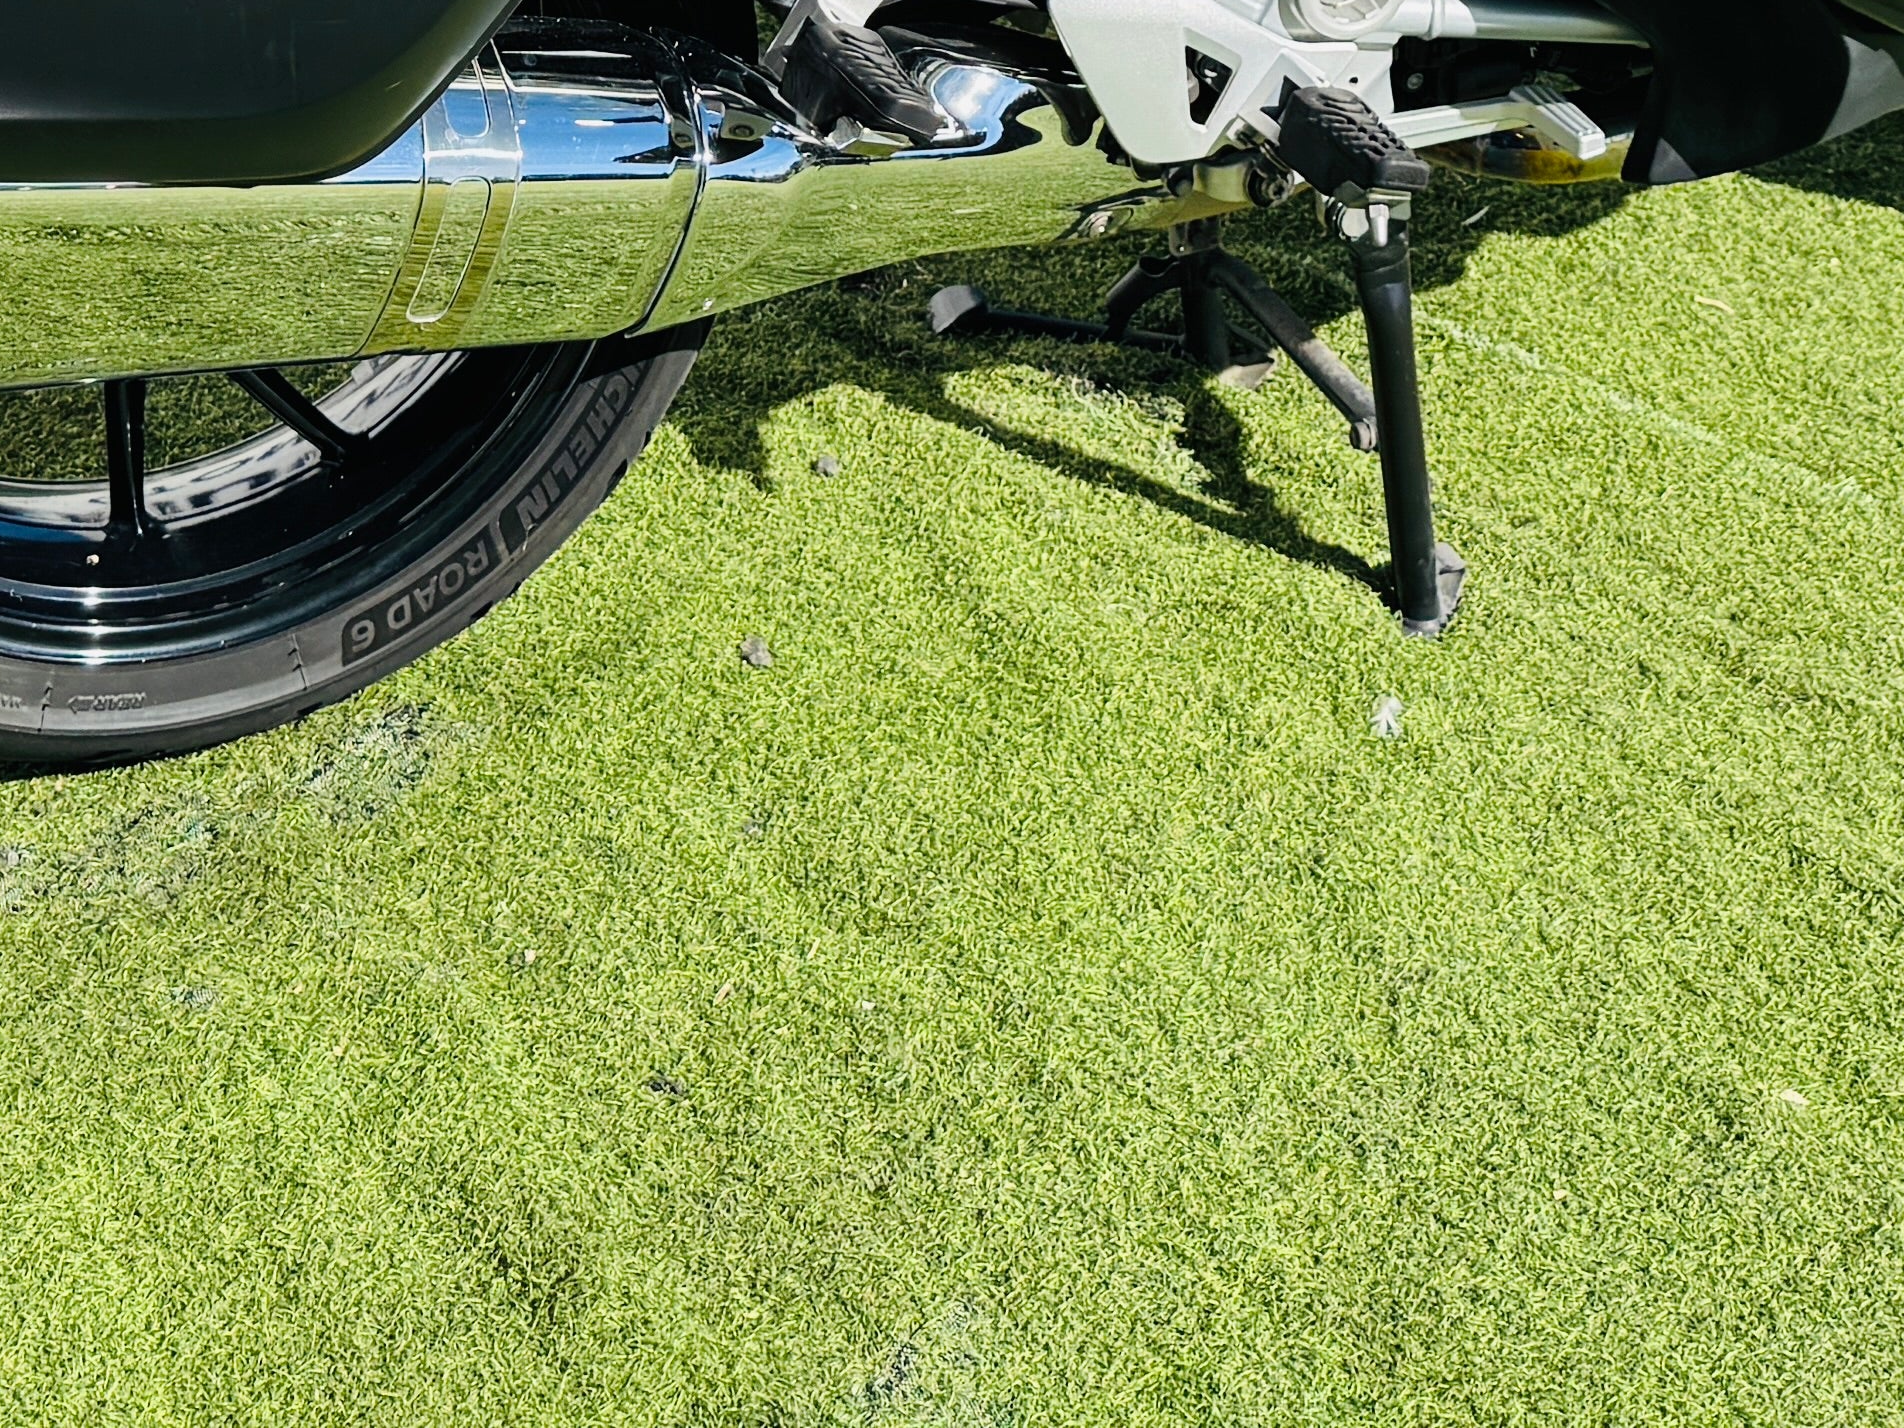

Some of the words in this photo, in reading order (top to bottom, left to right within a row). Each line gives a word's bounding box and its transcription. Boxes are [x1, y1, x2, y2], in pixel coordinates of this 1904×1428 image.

[515, 356, 656, 528] ICHELIN
[385, 544, 491, 631] ROAD
[350, 622, 377, 654] 6
[92, 692, 147, 713] REAR
